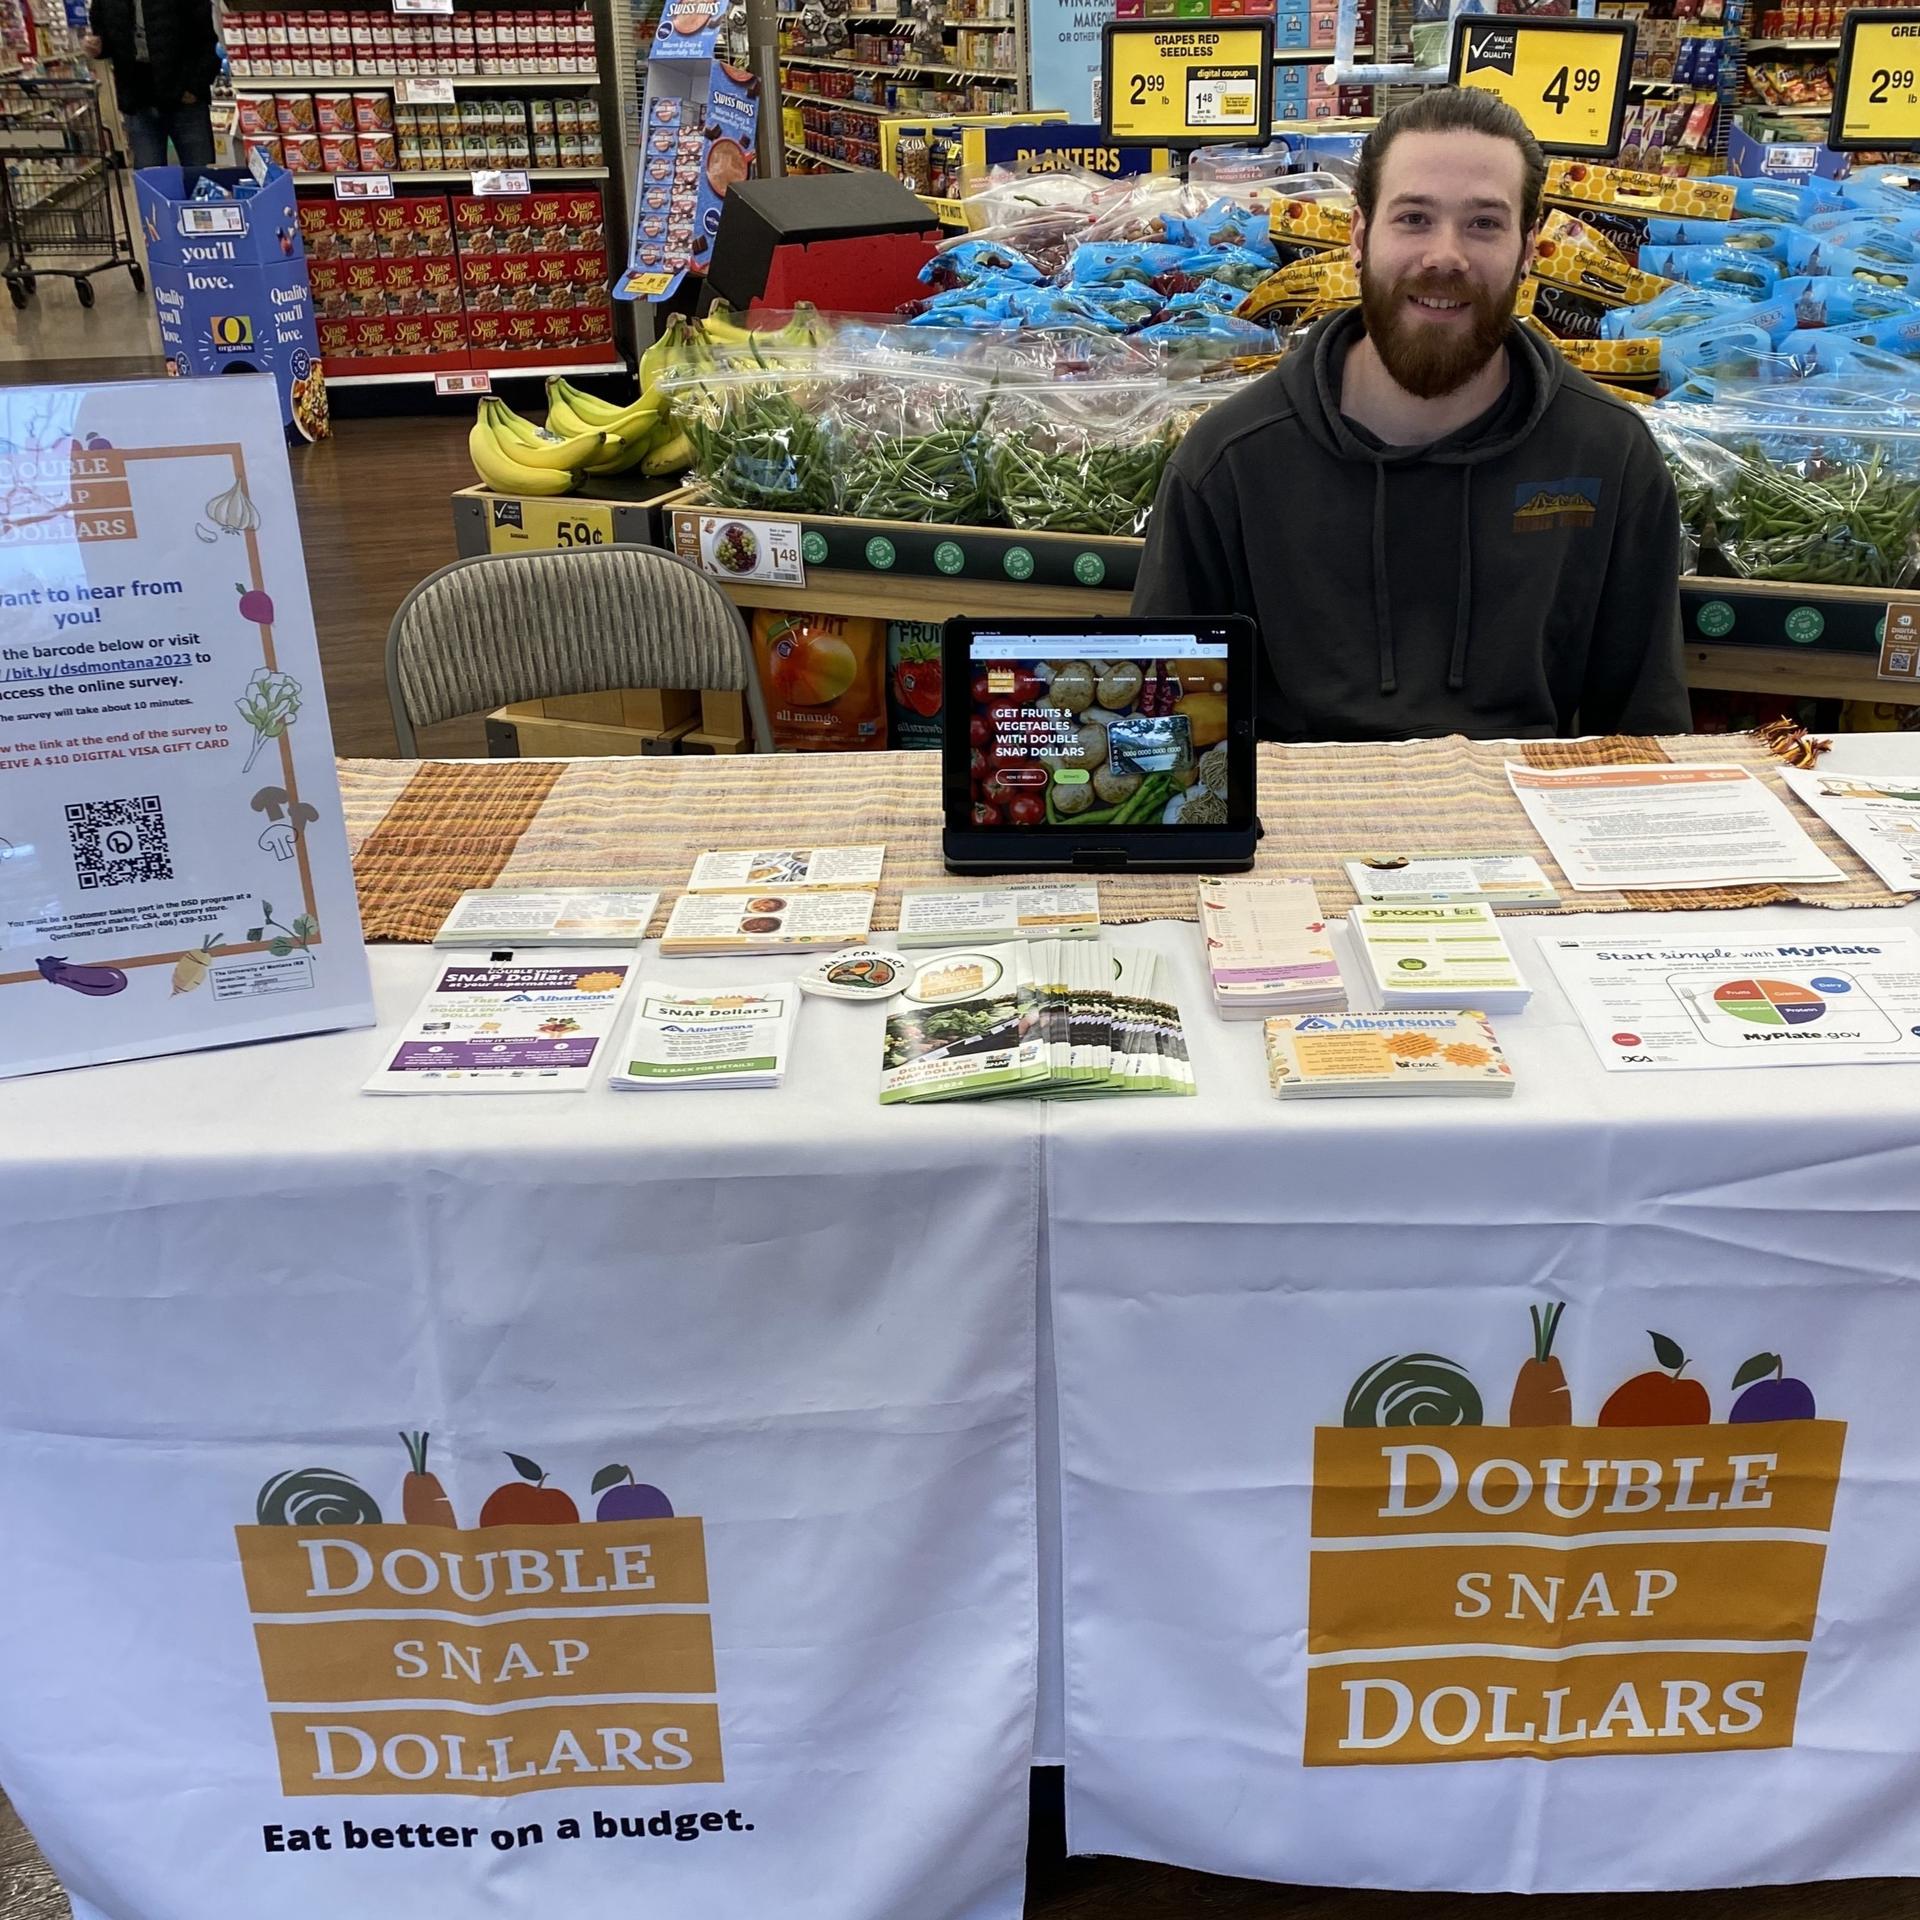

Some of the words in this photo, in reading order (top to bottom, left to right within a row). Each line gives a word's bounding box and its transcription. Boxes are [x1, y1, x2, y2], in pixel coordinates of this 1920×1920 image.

[667, 3, 697, 16] SWISS
[698, 2, 720, 15] MISS
[1059, 33, 1071, 41] OR
[1074, 32, 1095, 41] OTHER
[1154, 34, 1195, 46] GRAPES
[1198, 34, 1220, 44] RED
[1160, 47, 1213, 57] SEEDLESS
[1483, 51, 1512, 60] QUALITY
[1197, 69, 1221, 79] digital
[1222, 70, 1248, 79] coupon
[713, 91, 735, 107] SWISS
[736, 100, 754, 117] MISS
[1162, 97, 1169, 105] lb
[1908, 95, 1917, 104] lb
[1017, 147, 1121, 173] PLANTERS
[1650, 176, 1677, 193] Apple
[1694, 189, 1720, 199] 907
[182, 242, 235, 264] you'll
[187, 272, 234, 290] love.
[155, 287, 184, 310] Quality
[271, 285, 308, 306] Quality
[159, 309, 181, 326] you'll
[274, 304, 303, 327] you'll
[162, 327, 182, 344] love.
[276, 327, 303, 344] love.
[218, 344, 253, 353] organics
[47, 588, 70, 603] to
[76, 584, 125, 601] hear
[131, 580, 183, 597] from
[54, 607, 101, 630] you!
[900, 625, 943, 643] FRUI
[1891, 627, 1917, 635] DIGITAL
[3, 648, 29, 661] the
[33, 642, 95, 658] barcode
[99, 638, 144, 653] below
[148, 637, 164, 648] or
[168, 633, 201, 647] visit
[196, 652, 211, 663] to
[49, 683, 75, 697] the
[78, 678, 125, 693] online
[129, 675, 183, 693] survey.
[17, 711, 52, 721] survey
[54, 708, 73, 717] will
[76, 706, 99, 716] take
[101, 702, 131, 713] about
[134, 701, 147, 710] 10
[149, 697, 193, 709] minutes.
[777, 710, 790, 721] all
[795, 712, 842, 725] mango.
[996, 709, 1018, 718] GET
[1021, 709, 1061, 718] FRUITS
[1064, 709, 1072, 718] &
[996, 722, 1070, 731] VEGETABLES
[15, 743, 36, 753] the
[39, 740, 62, 749] link
[67, 738, 79, 747] at
[82, 736, 103, 745] the
[106, 733, 130, 743] end
[133, 730, 146, 741] of
[149, 729, 168, 738] the
[172, 725, 212, 737] survey
[215, 724, 228, 732] to
[996, 734, 1027, 743] WITH
[1030, 734, 1078, 743] DOUBLE
[33, 757, 42, 766] A
[46, 755, 69, 766] $10
[73, 750, 126, 763] DIGITAL
[129, 746, 160, 757] VISA
[163, 742, 192, 753] GIFT
[195, 738, 229, 750] CARD
[996, 747, 1028, 757] SNAP
[1031, 747, 1085, 757] DOLLARS
[7, 920, 25, 929] You
[26, 917, 53, 926] must
[69, 910, 107, 921] customer
[109, 906, 135, 916] taking
[137, 904, 154, 914] part
[166, 901, 179, 909] the
[181, 898, 198, 907] DSD
[200, 894, 234, 906] program
[36, 923, 72, 933] Montana
[74, 918, 106, 929] farmers
[108, 915, 140, 925] market,
[142, 912, 160, 921] CSA,
[173, 906, 203, 918] grocery
[205, 904, 228, 912] store.
[1373, 908, 1444, 917] grocery
[1454, 907, 1478, 915] list
[50, 929, 95, 941] Questions?
[98, 926, 113, 935] Call
[115, 924, 129, 932] Ian
[155, 918, 178, 929] (406)
[179, 914, 218, 924] 439-5331
[1597, 952, 1656, 961] Start
[1661, 948, 1733, 962] simple
[1741, 951, 1774, 959] with
[1776, 945, 1882, 957] MyPlate
[445, 974, 501, 982] SNAP
[506, 973, 579, 982] Dollars
[492, 980, 573, 989] supermarket!
[535, 994, 614, 1002] Albertsons
[659, 1007, 705, 1016] SNAP
[709, 1007, 769, 1016] Dollars
[686, 1024, 754, 1033] Albertsons
[1340, 1018, 1457, 1030] Albertsons
[1743, 1031, 1861, 1042] MyPlate.gov
[889, 1073, 922, 1083] SNAP
[924, 1062, 979, 1076] DOLLARS
[899, 1061, 950, 1075] DOUBLE
[1454, 1570, 1677, 1623] SNAP
[394, 1640, 589, 1685] SNAP
[263, 1824, 332, 1852] Eat
[344, 1821, 478, 1850] better
[490, 1820, 543, 1850] on
[556, 1817, 580, 1839] a
[593, 1808, 755, 1841] budget.
